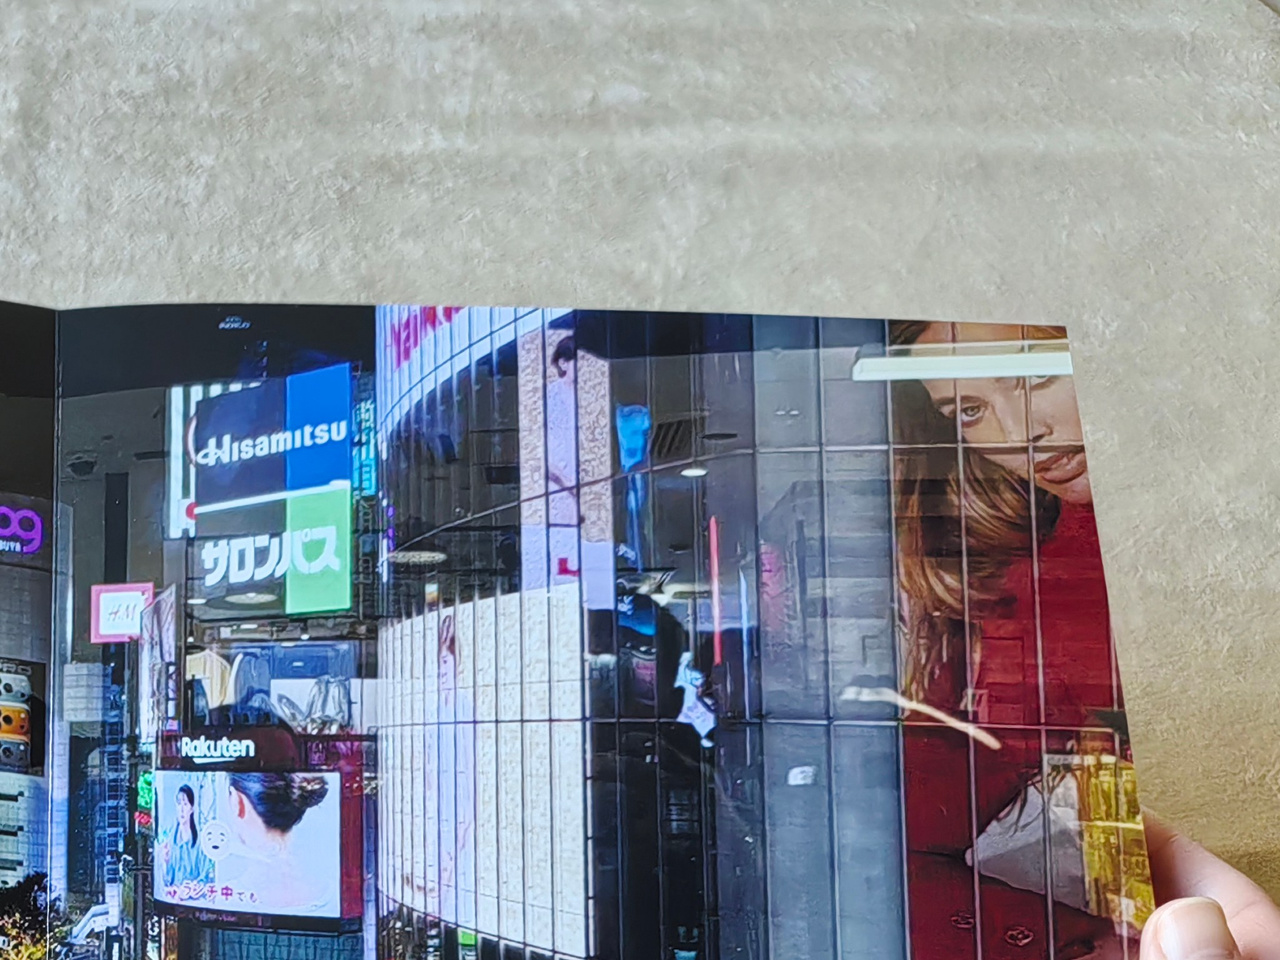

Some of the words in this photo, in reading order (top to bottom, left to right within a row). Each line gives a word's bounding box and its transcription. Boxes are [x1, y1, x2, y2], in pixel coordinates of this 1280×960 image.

[196, 420, 348, 466] Hisamitsu
[202, 526, 340, 587] サロンパス
[181, 737, 256, 758] Rakuten
